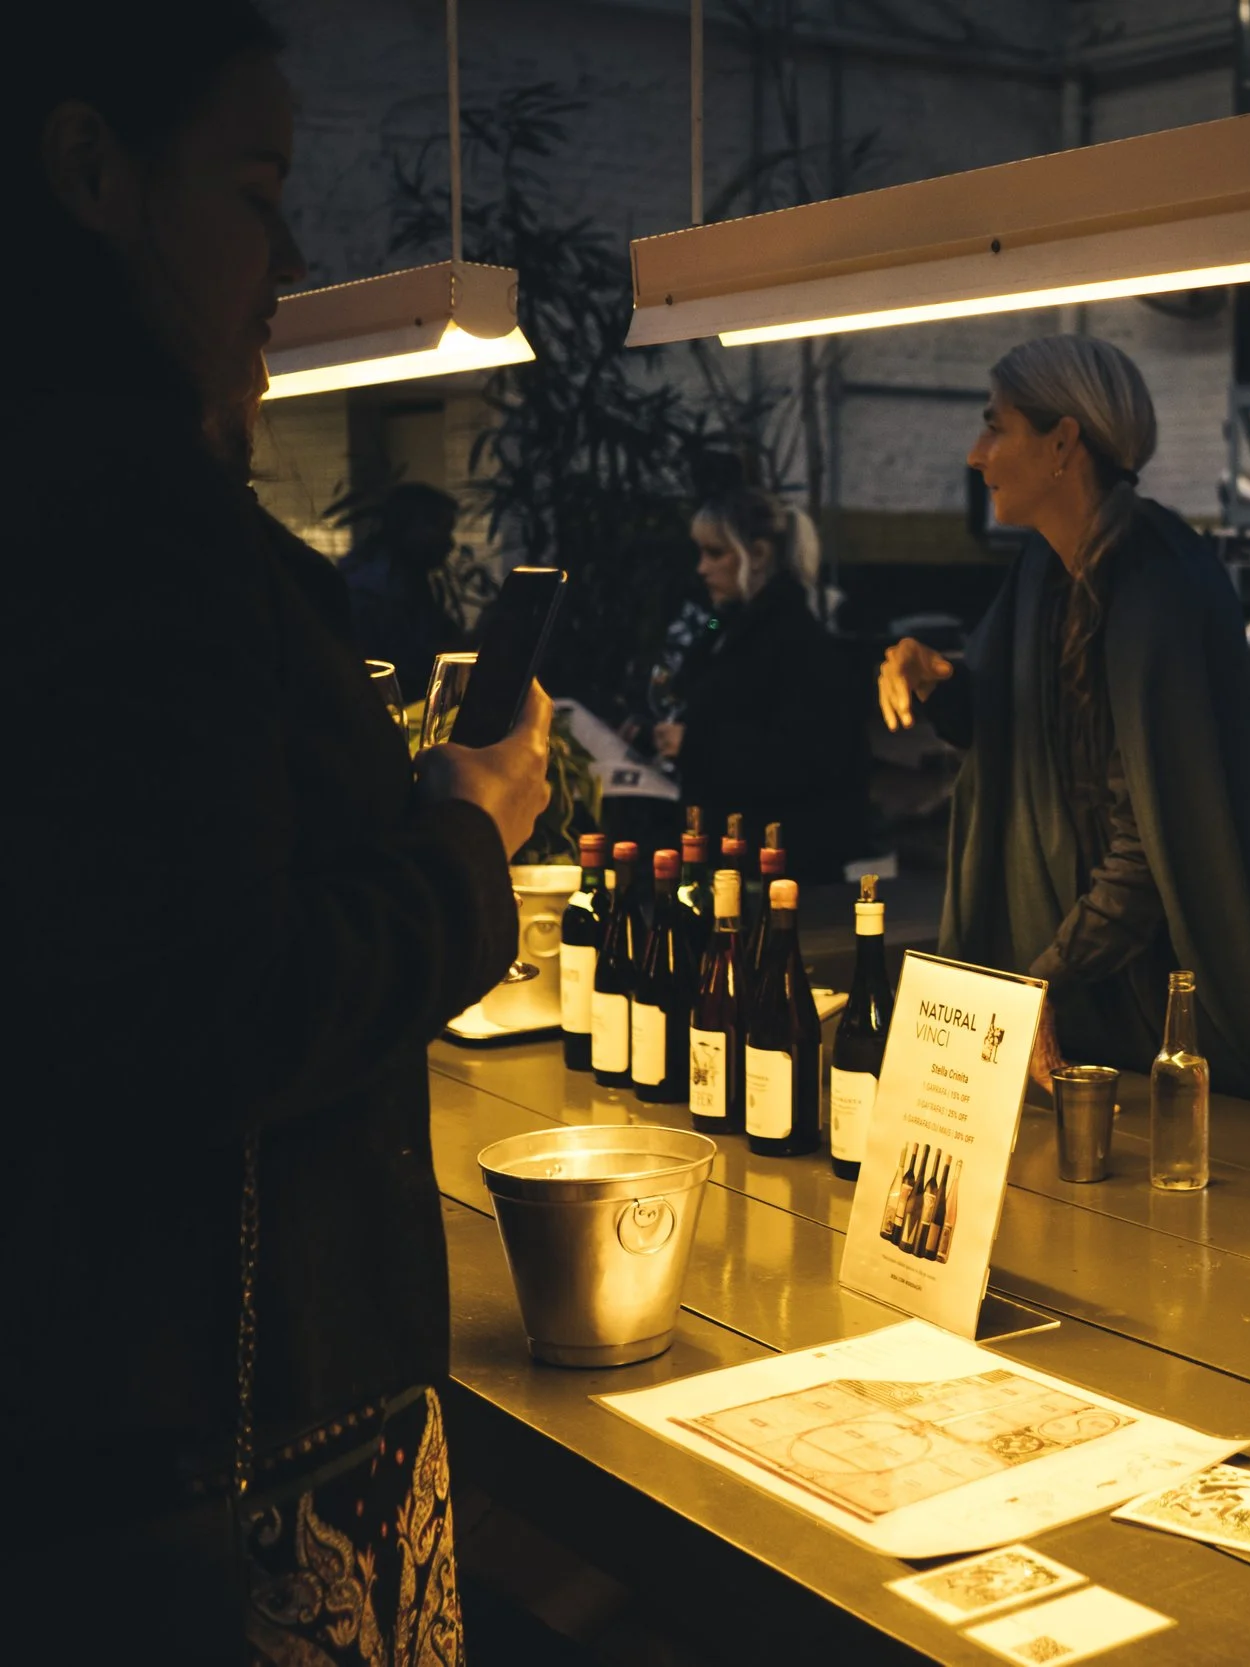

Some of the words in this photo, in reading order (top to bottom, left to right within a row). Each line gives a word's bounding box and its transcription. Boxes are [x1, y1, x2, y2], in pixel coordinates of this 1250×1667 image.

[919, 999, 977, 1032] NATURAL
[916, 1020, 950, 1048] VINCI
[931, 1063, 948, 1078] Stella
[948, 1068, 969, 1084] Crinita
[951, 1090, 960, 1101] 15%
[960, 1093, 971, 1103] OFF
[947, 1108, 957, 1119] 25%
[958, 1112, 968, 1122] OFF
[964, 1134, 975, 1144] OFF
